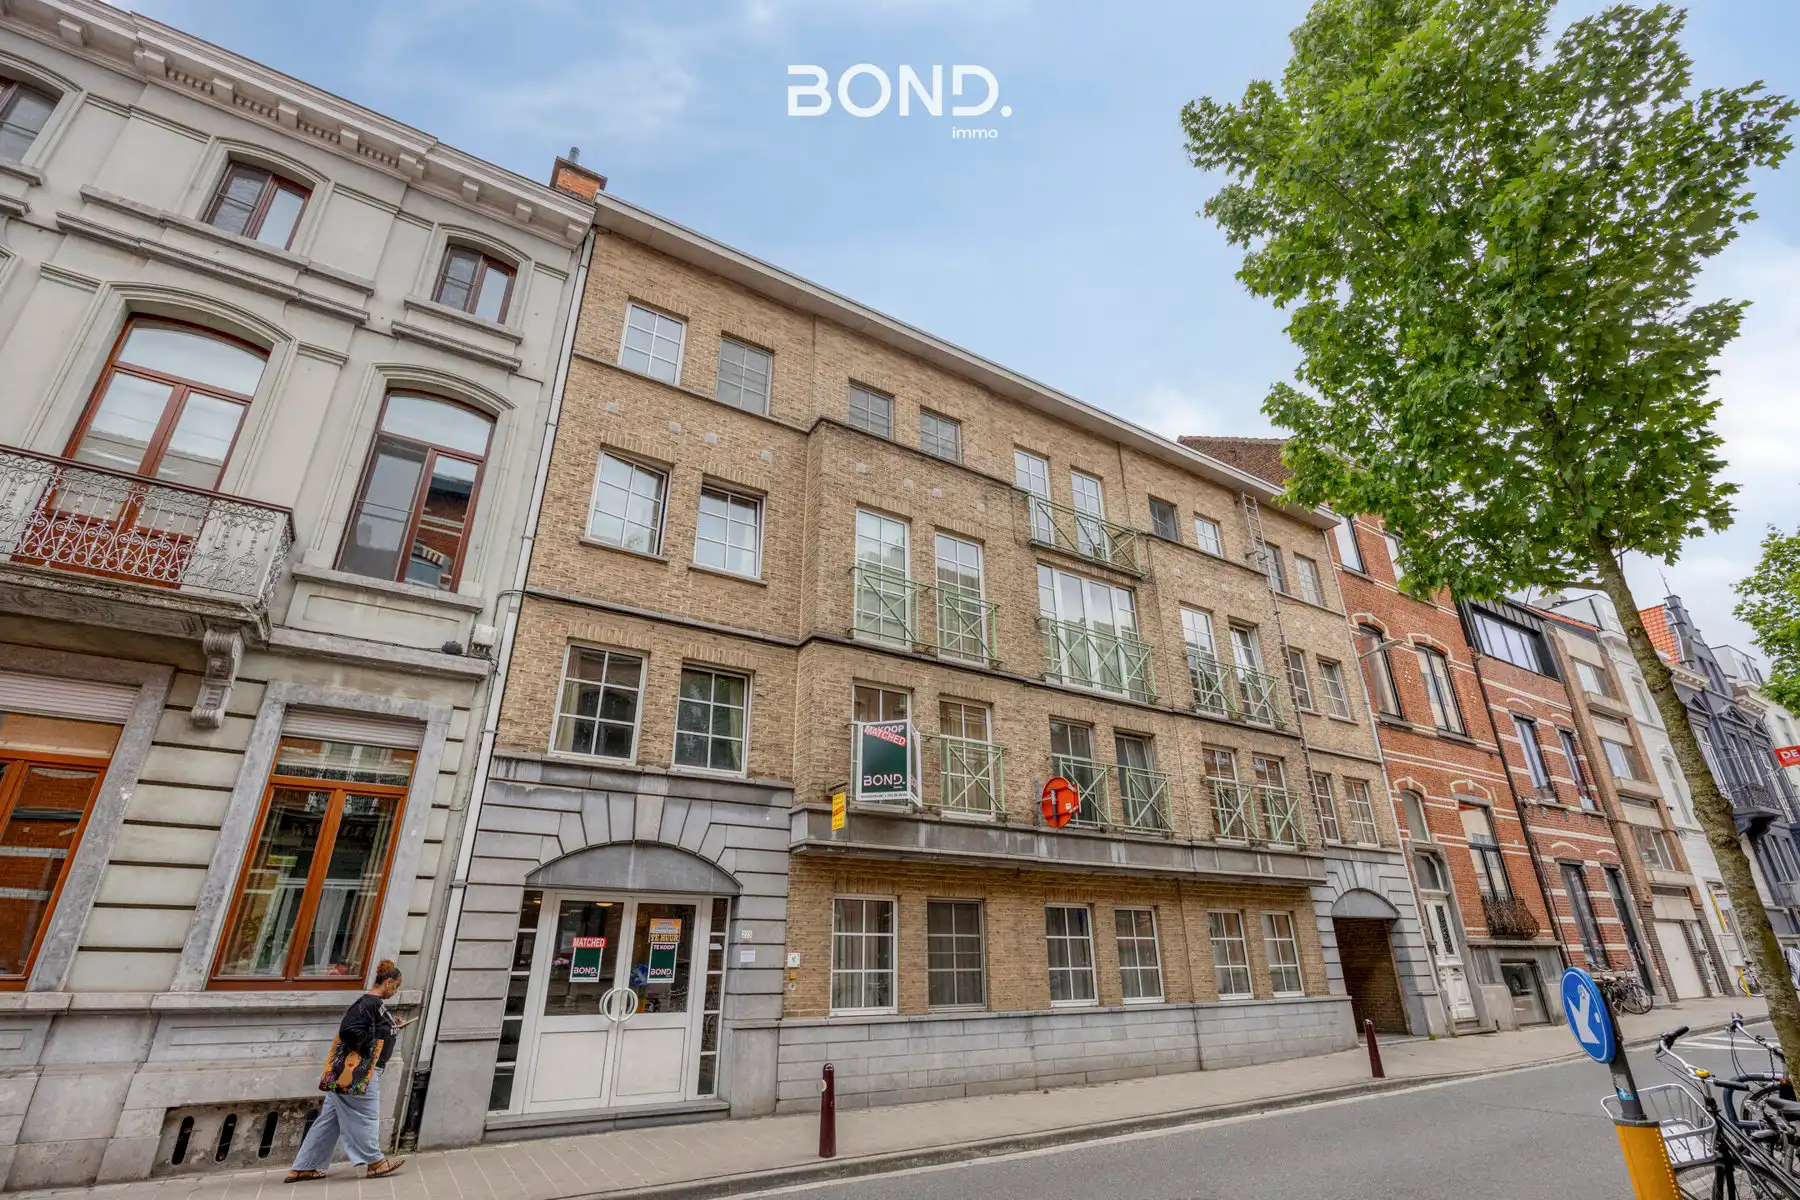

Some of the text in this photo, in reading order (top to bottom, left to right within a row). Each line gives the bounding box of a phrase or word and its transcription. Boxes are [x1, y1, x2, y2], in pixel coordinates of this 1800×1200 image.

[864, 725, 906, 746] MATCHED
[863, 774, 905, 786] BOND.
[573, 937, 605, 948] MATCHED
